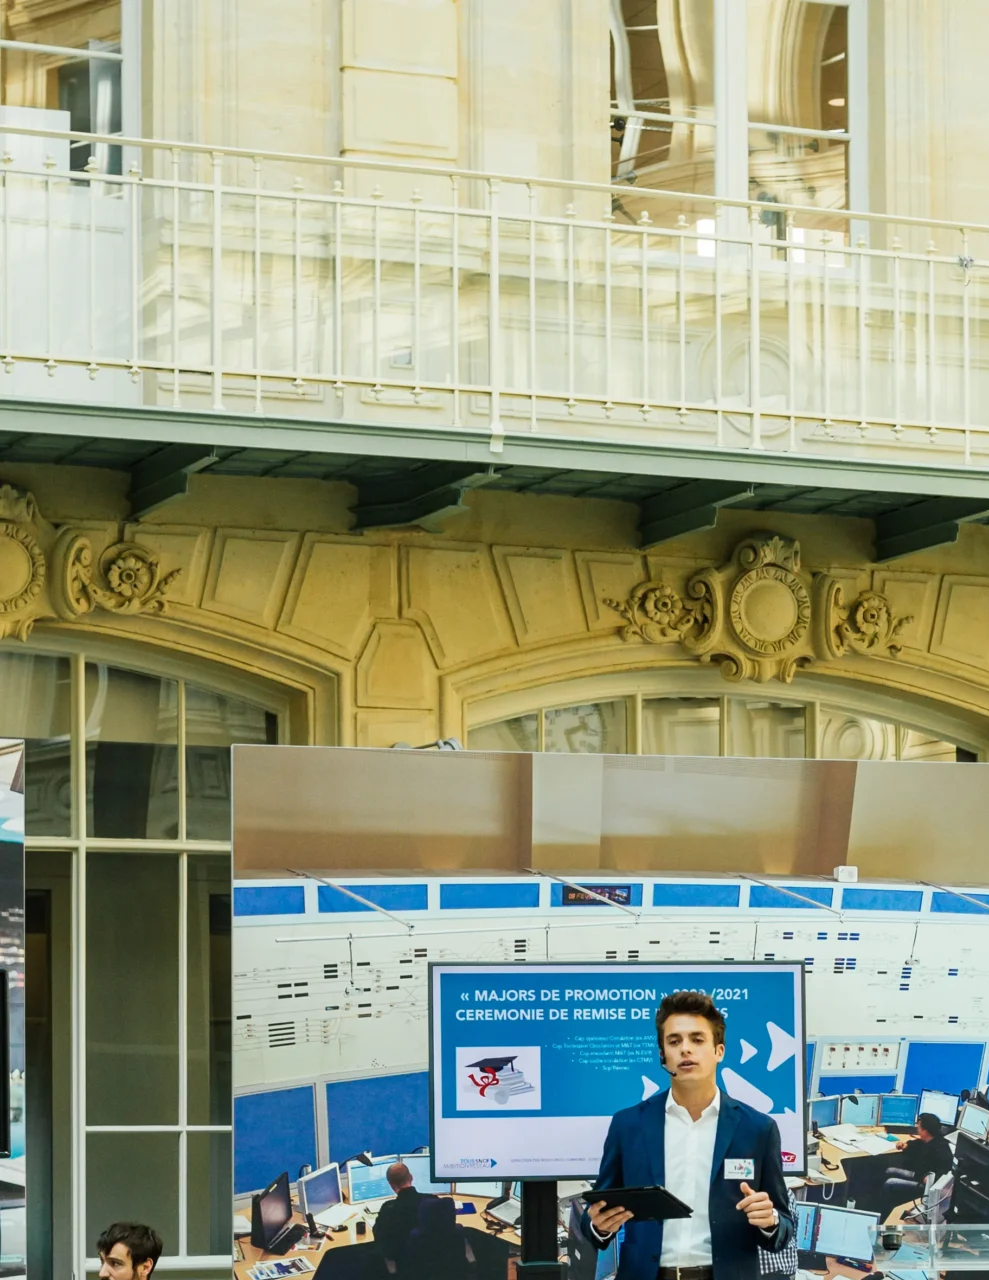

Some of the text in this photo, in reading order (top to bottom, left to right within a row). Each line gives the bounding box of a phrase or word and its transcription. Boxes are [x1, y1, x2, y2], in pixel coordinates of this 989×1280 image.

[475, 990, 536, 1001] MAJORS
[541, 990, 560, 1001] DE
[565, 989, 656, 1001] PROMOTION
[455, 1009, 544, 1021] CEREMONIE
[549, 1008, 568, 1020] DE
[573, 1008, 626, 1020] REMISE
[631, 1008, 650, 1020] DE
